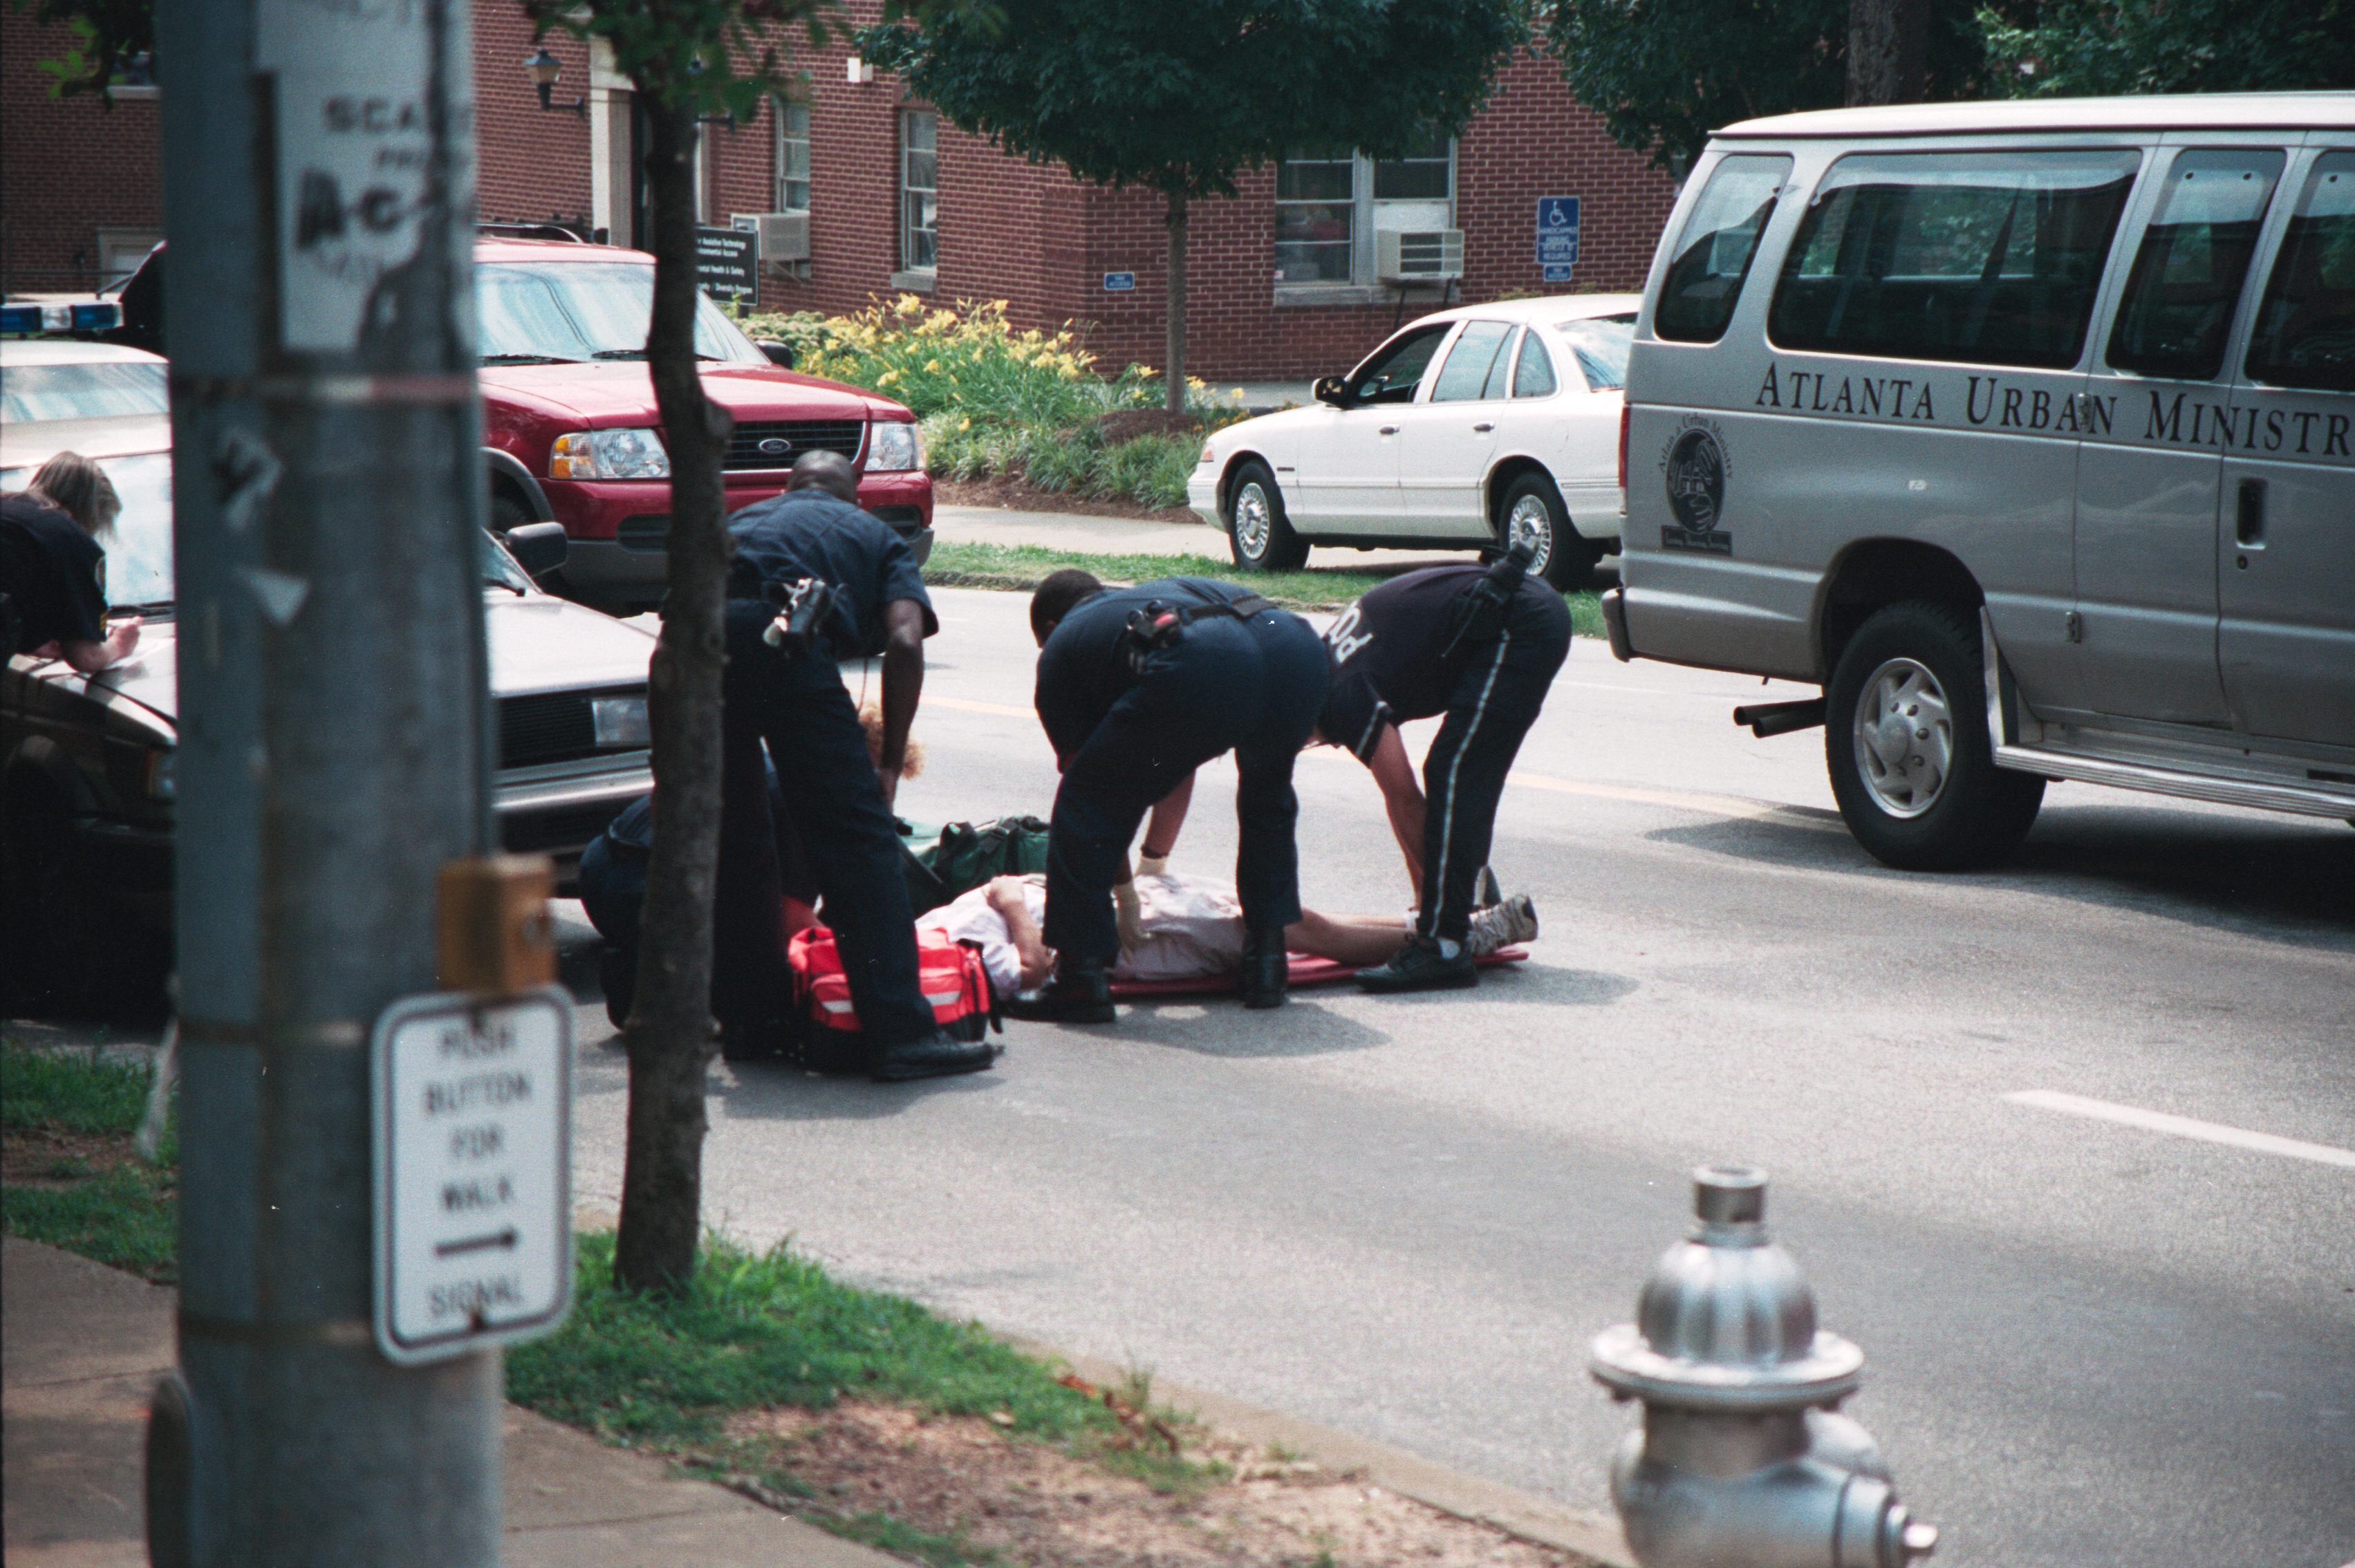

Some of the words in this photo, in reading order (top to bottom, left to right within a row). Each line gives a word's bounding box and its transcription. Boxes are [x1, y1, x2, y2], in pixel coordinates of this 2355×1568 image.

[722, 238, 746, 250] Technology
[1543, 252, 1572, 260] REQUIRED
[710, 265, 725, 274] Health
[730, 266, 745, 277] Safety
[1755, 361, 1935, 420] ATLANTA
[1966, 376, 2118, 435] URBAN
[2143, 390, 2351, 457] MINISTR
[426, 1071, 532, 1116] BUTTON
[451, 1122, 504, 1159] FOR
[441, 1176, 514, 1213] WALK
[429, 1273, 523, 1317] SIGNAL
